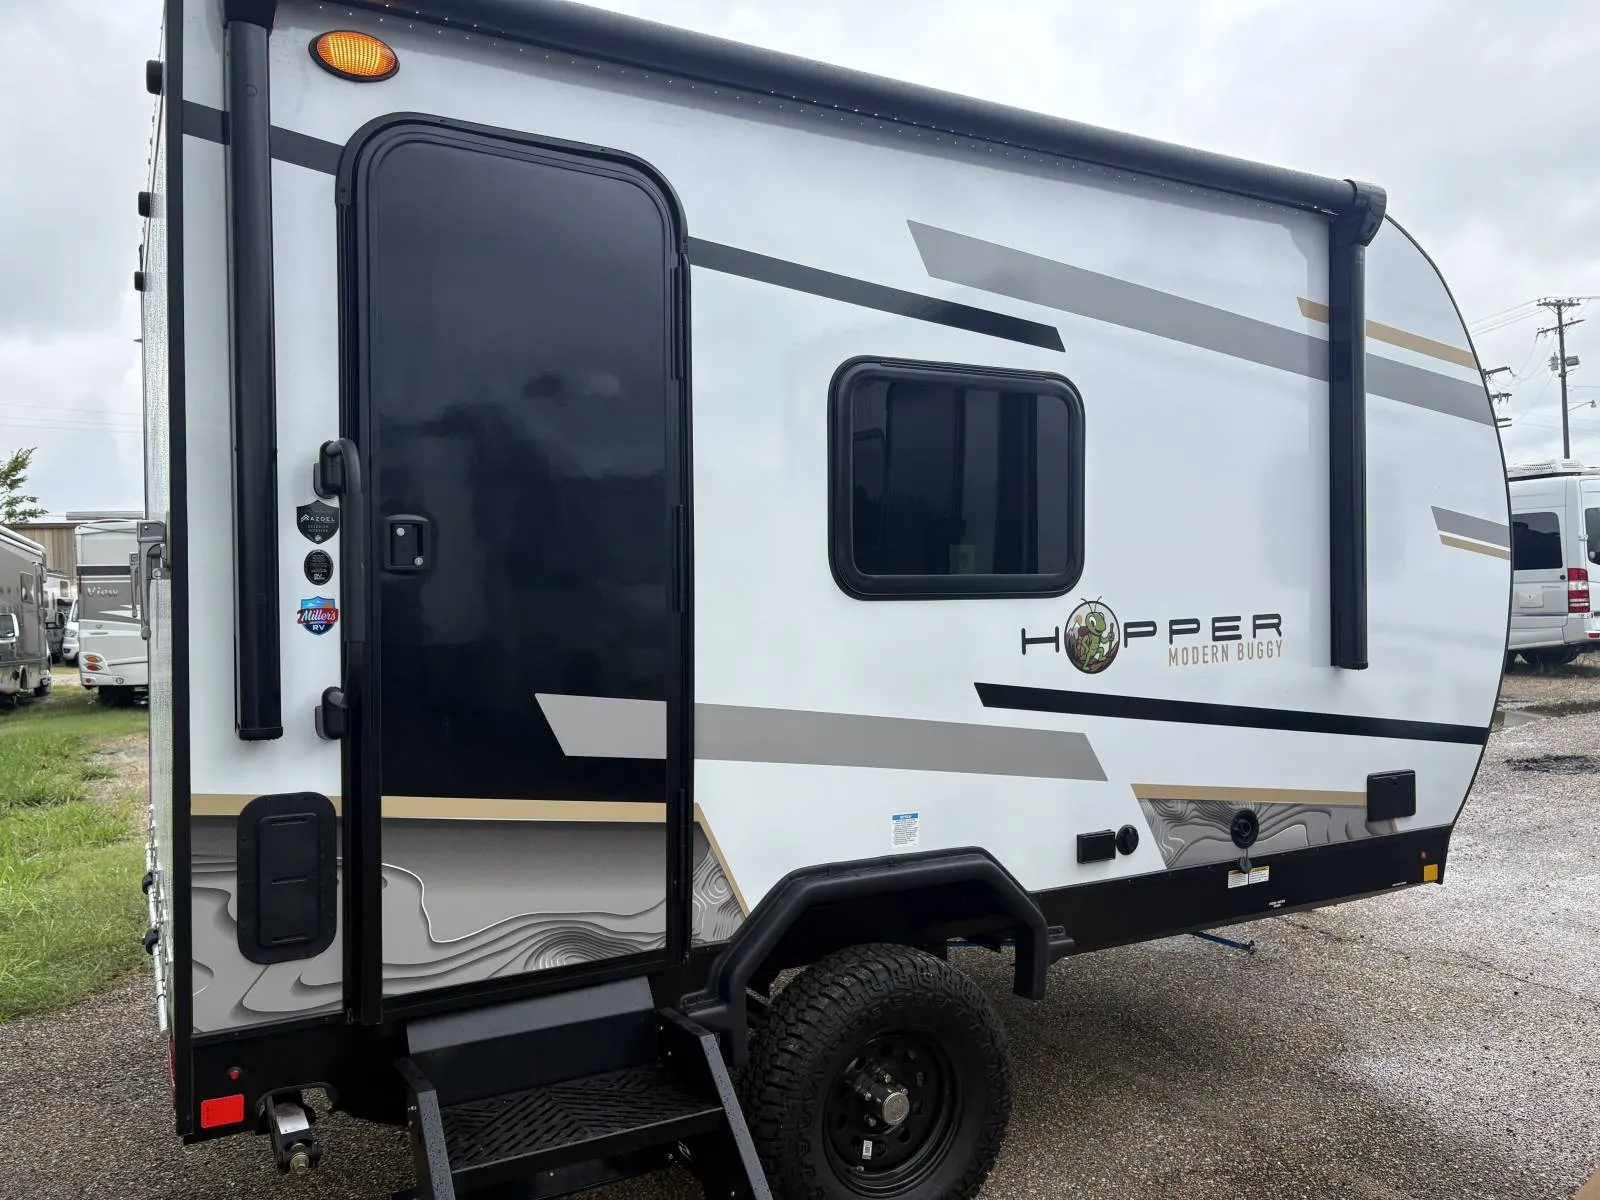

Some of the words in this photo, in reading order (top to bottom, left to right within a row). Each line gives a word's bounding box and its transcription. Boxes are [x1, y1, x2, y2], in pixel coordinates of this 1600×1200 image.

[87, 586, 119, 596] View
[301, 609, 336, 622] Miller's
[1168, 644, 1229, 668] MODERN
[1237, 639, 1283, 661] BUGGY
